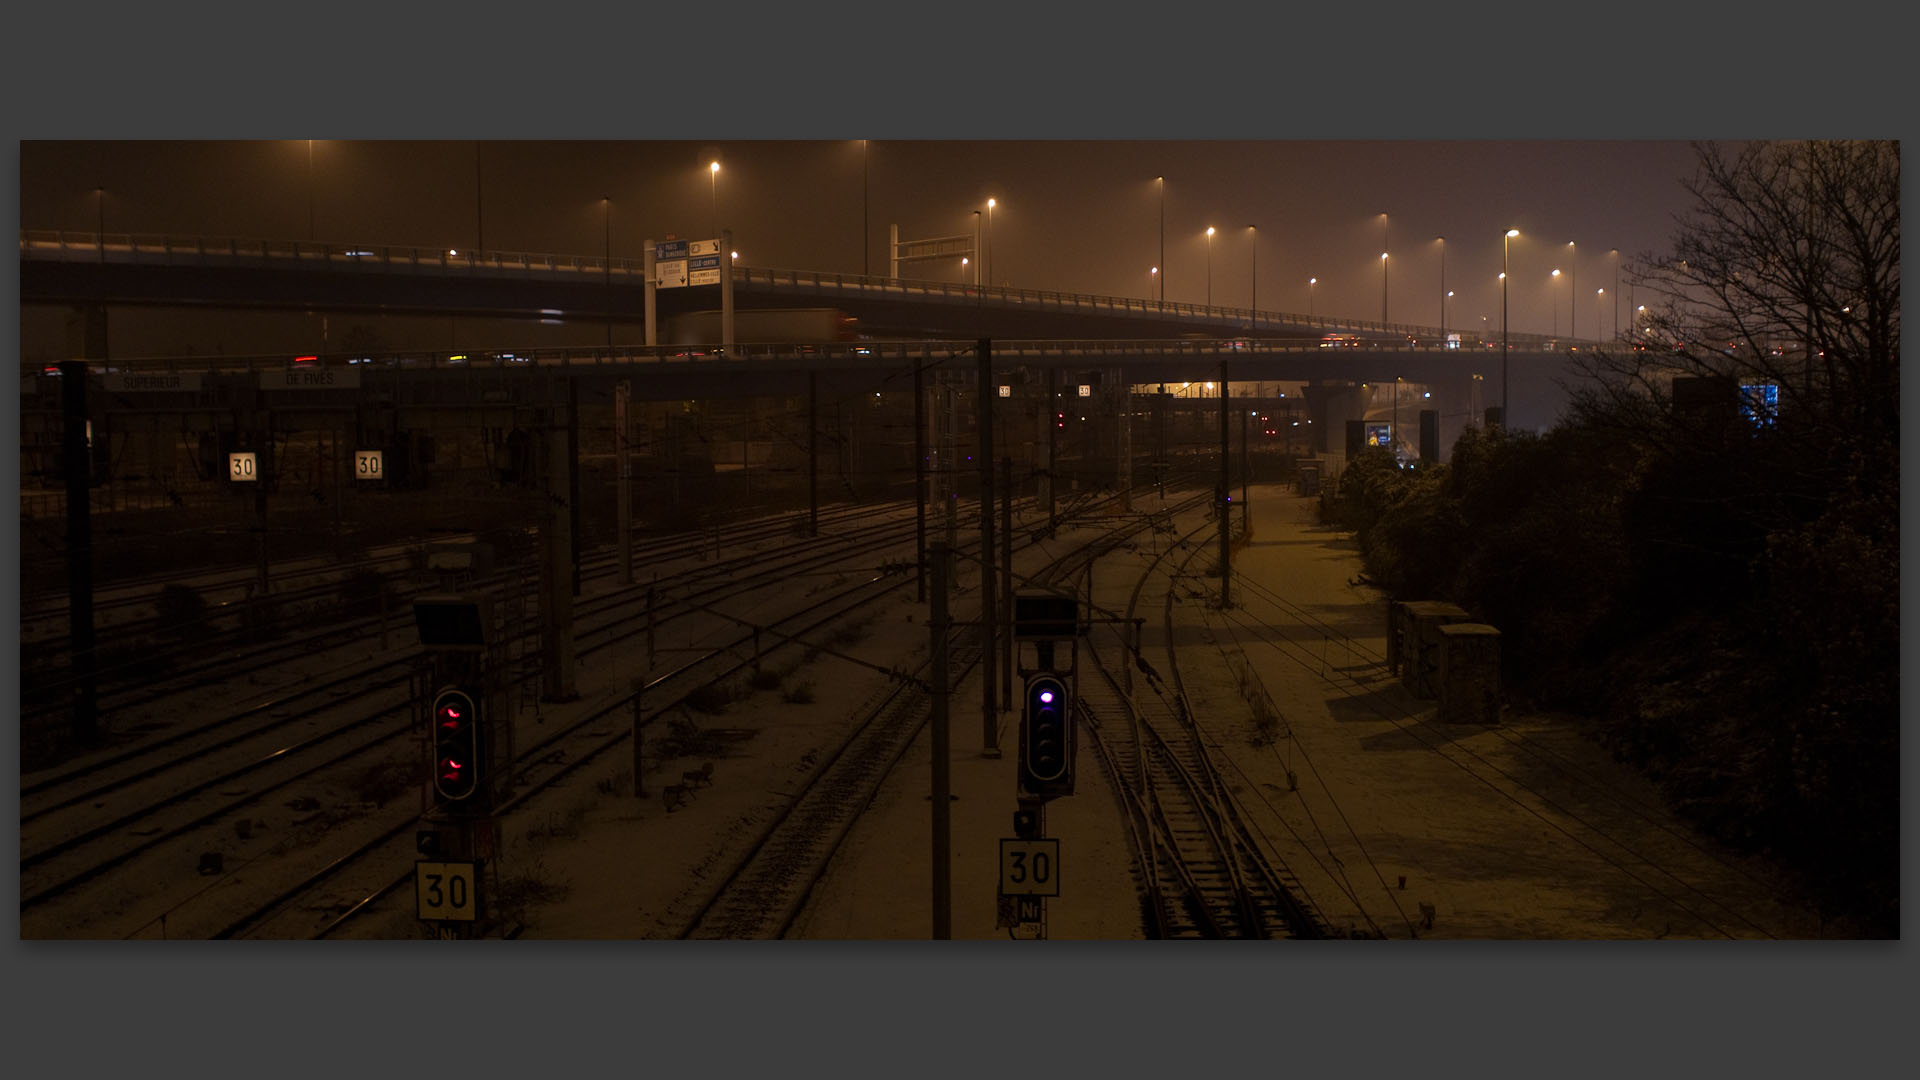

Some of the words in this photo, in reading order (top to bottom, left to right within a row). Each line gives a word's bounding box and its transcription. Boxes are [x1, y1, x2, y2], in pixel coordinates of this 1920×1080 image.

[304, 372, 334, 385] FIVES
[1001, 387, 1009, 395] 30
[1080, 387, 1089, 395] 30
[233, 458, 252, 475] 30
[359, 453, 378, 473] 30
[1010, 851, 1049, 883] 30
[426, 874, 466, 908] 30
